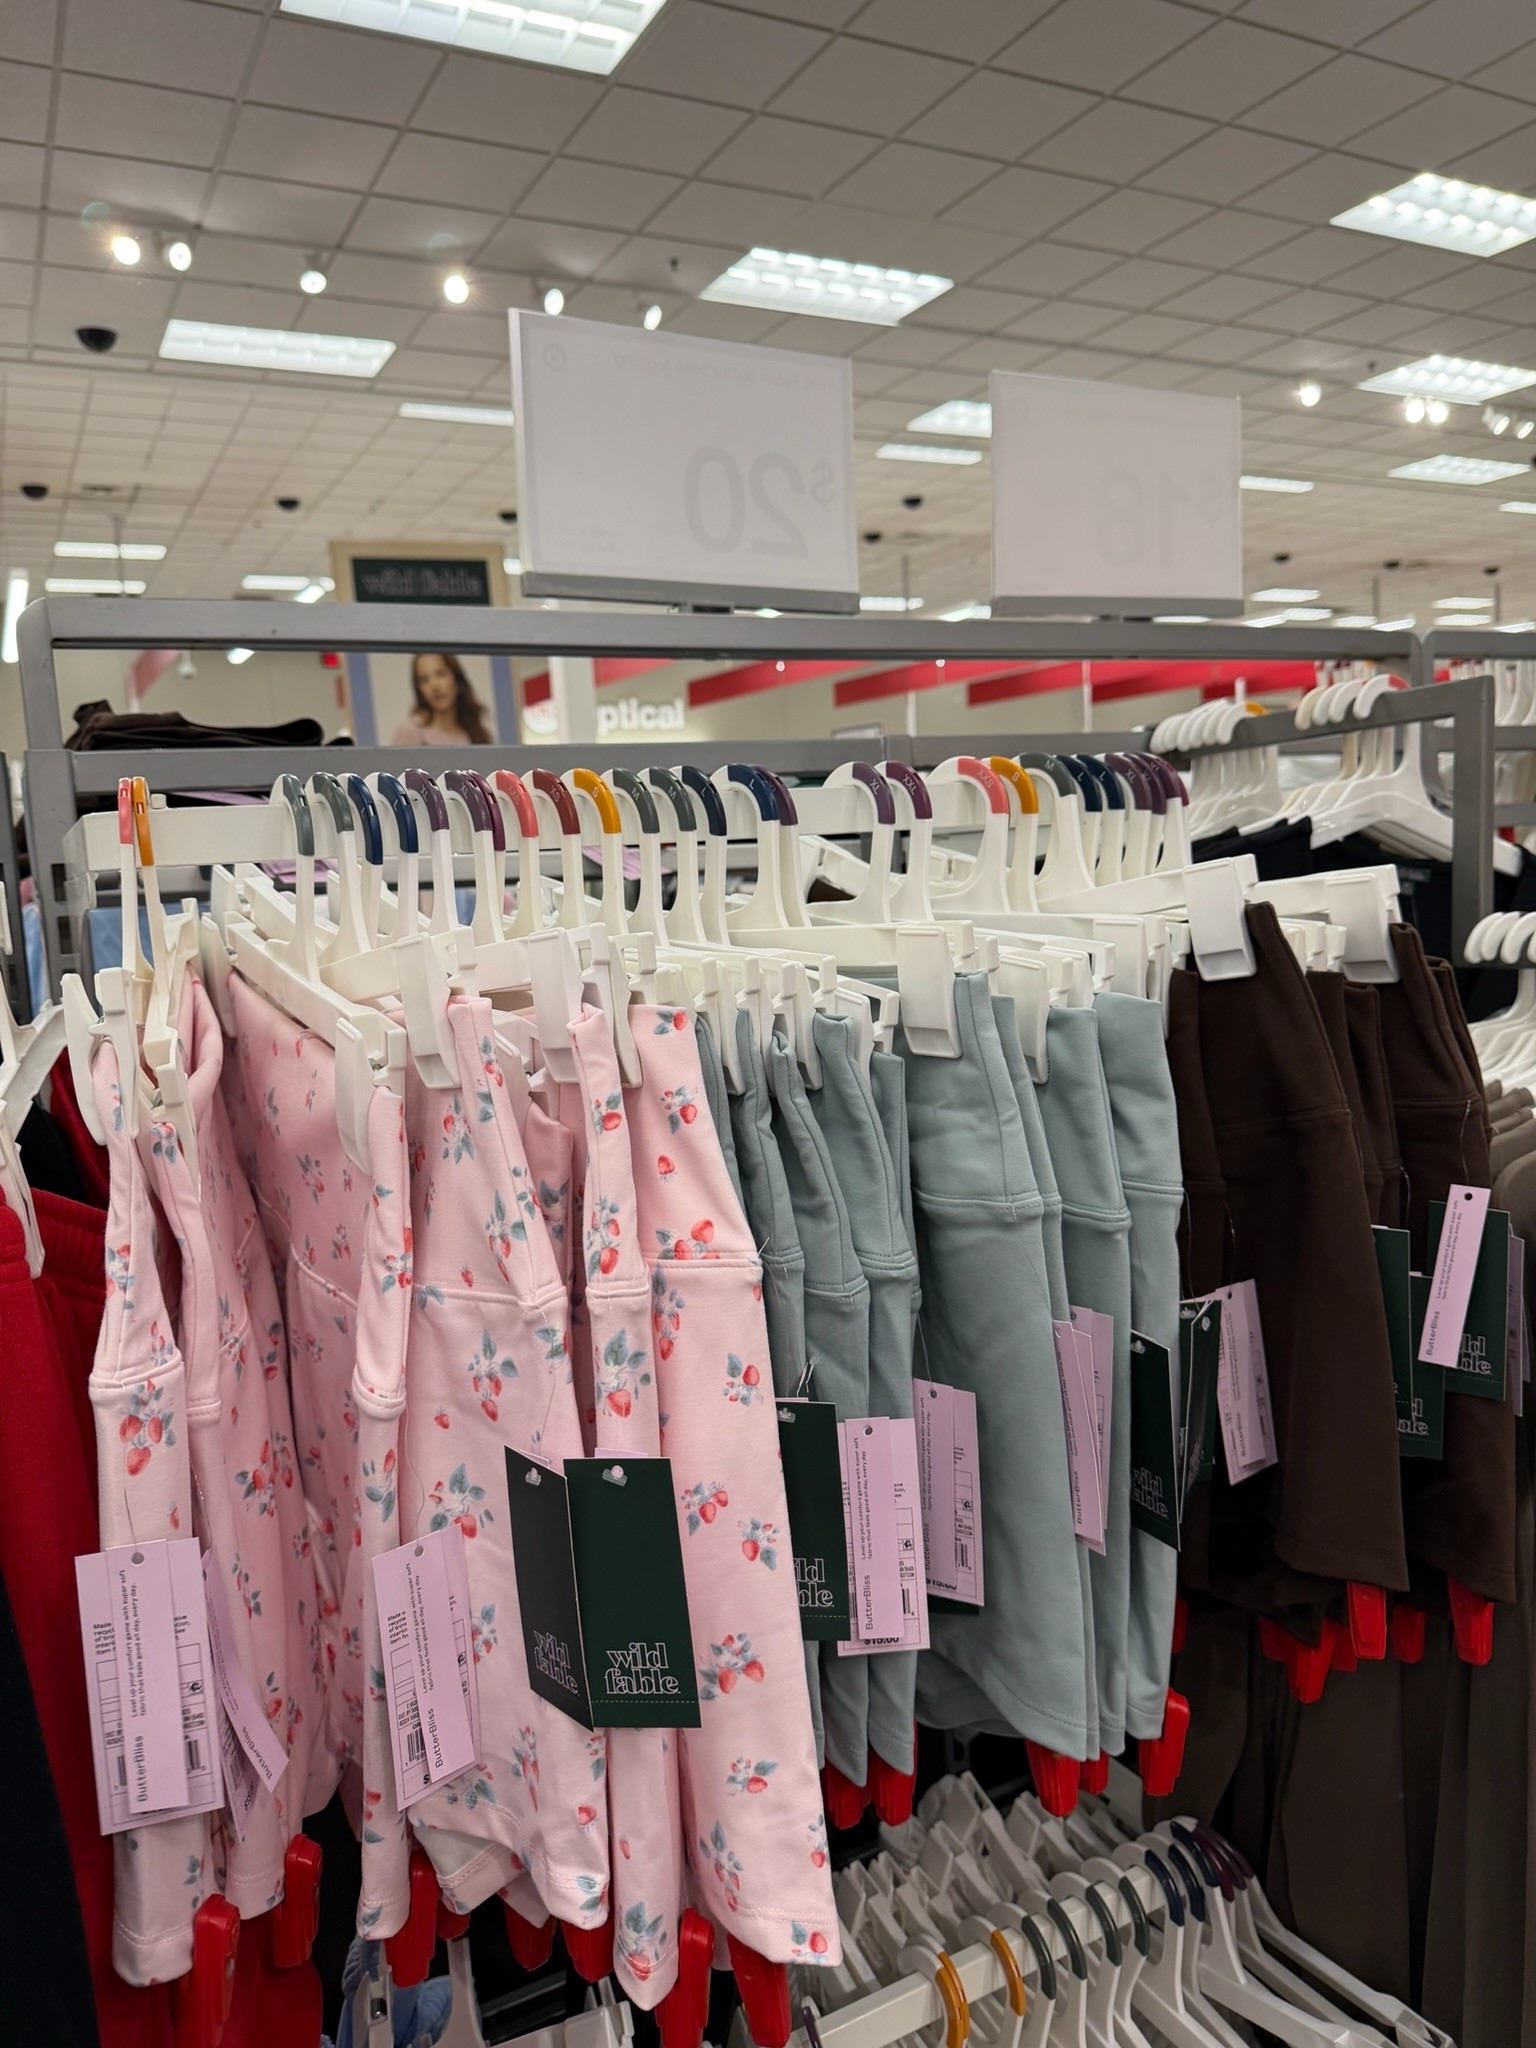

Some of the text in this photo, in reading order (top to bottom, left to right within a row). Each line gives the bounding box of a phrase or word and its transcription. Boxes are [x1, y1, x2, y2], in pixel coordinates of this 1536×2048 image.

[596, 697, 685, 737] ptical
[1044, 760, 1055, 772] M
[1124, 768, 1136, 784] XL
[631, 786, 640, 801] M
[668, 786, 677, 800] M
[749, 778, 755, 790] L
[870, 778, 880, 796] XL
[902, 774, 917, 796] XXL
[1456, 1352, 1491, 1374] ble
[793, 1558, 825, 1582] ild
[796, 1582, 833, 1607] ble
[864, 1575, 873, 1629] ButterBliss
[533, 1630, 571, 1669] wild
[606, 1642, 669, 1669] wild
[534, 1646, 579, 1695] fable
[605, 1667, 680, 1694] fable
[131, 1689, 136, 1697] up
[427, 1708, 443, 1768] ButterBliss
[242, 1726, 273, 1779] ButterBliss
[135, 1736, 146, 1802] ButterBliss
